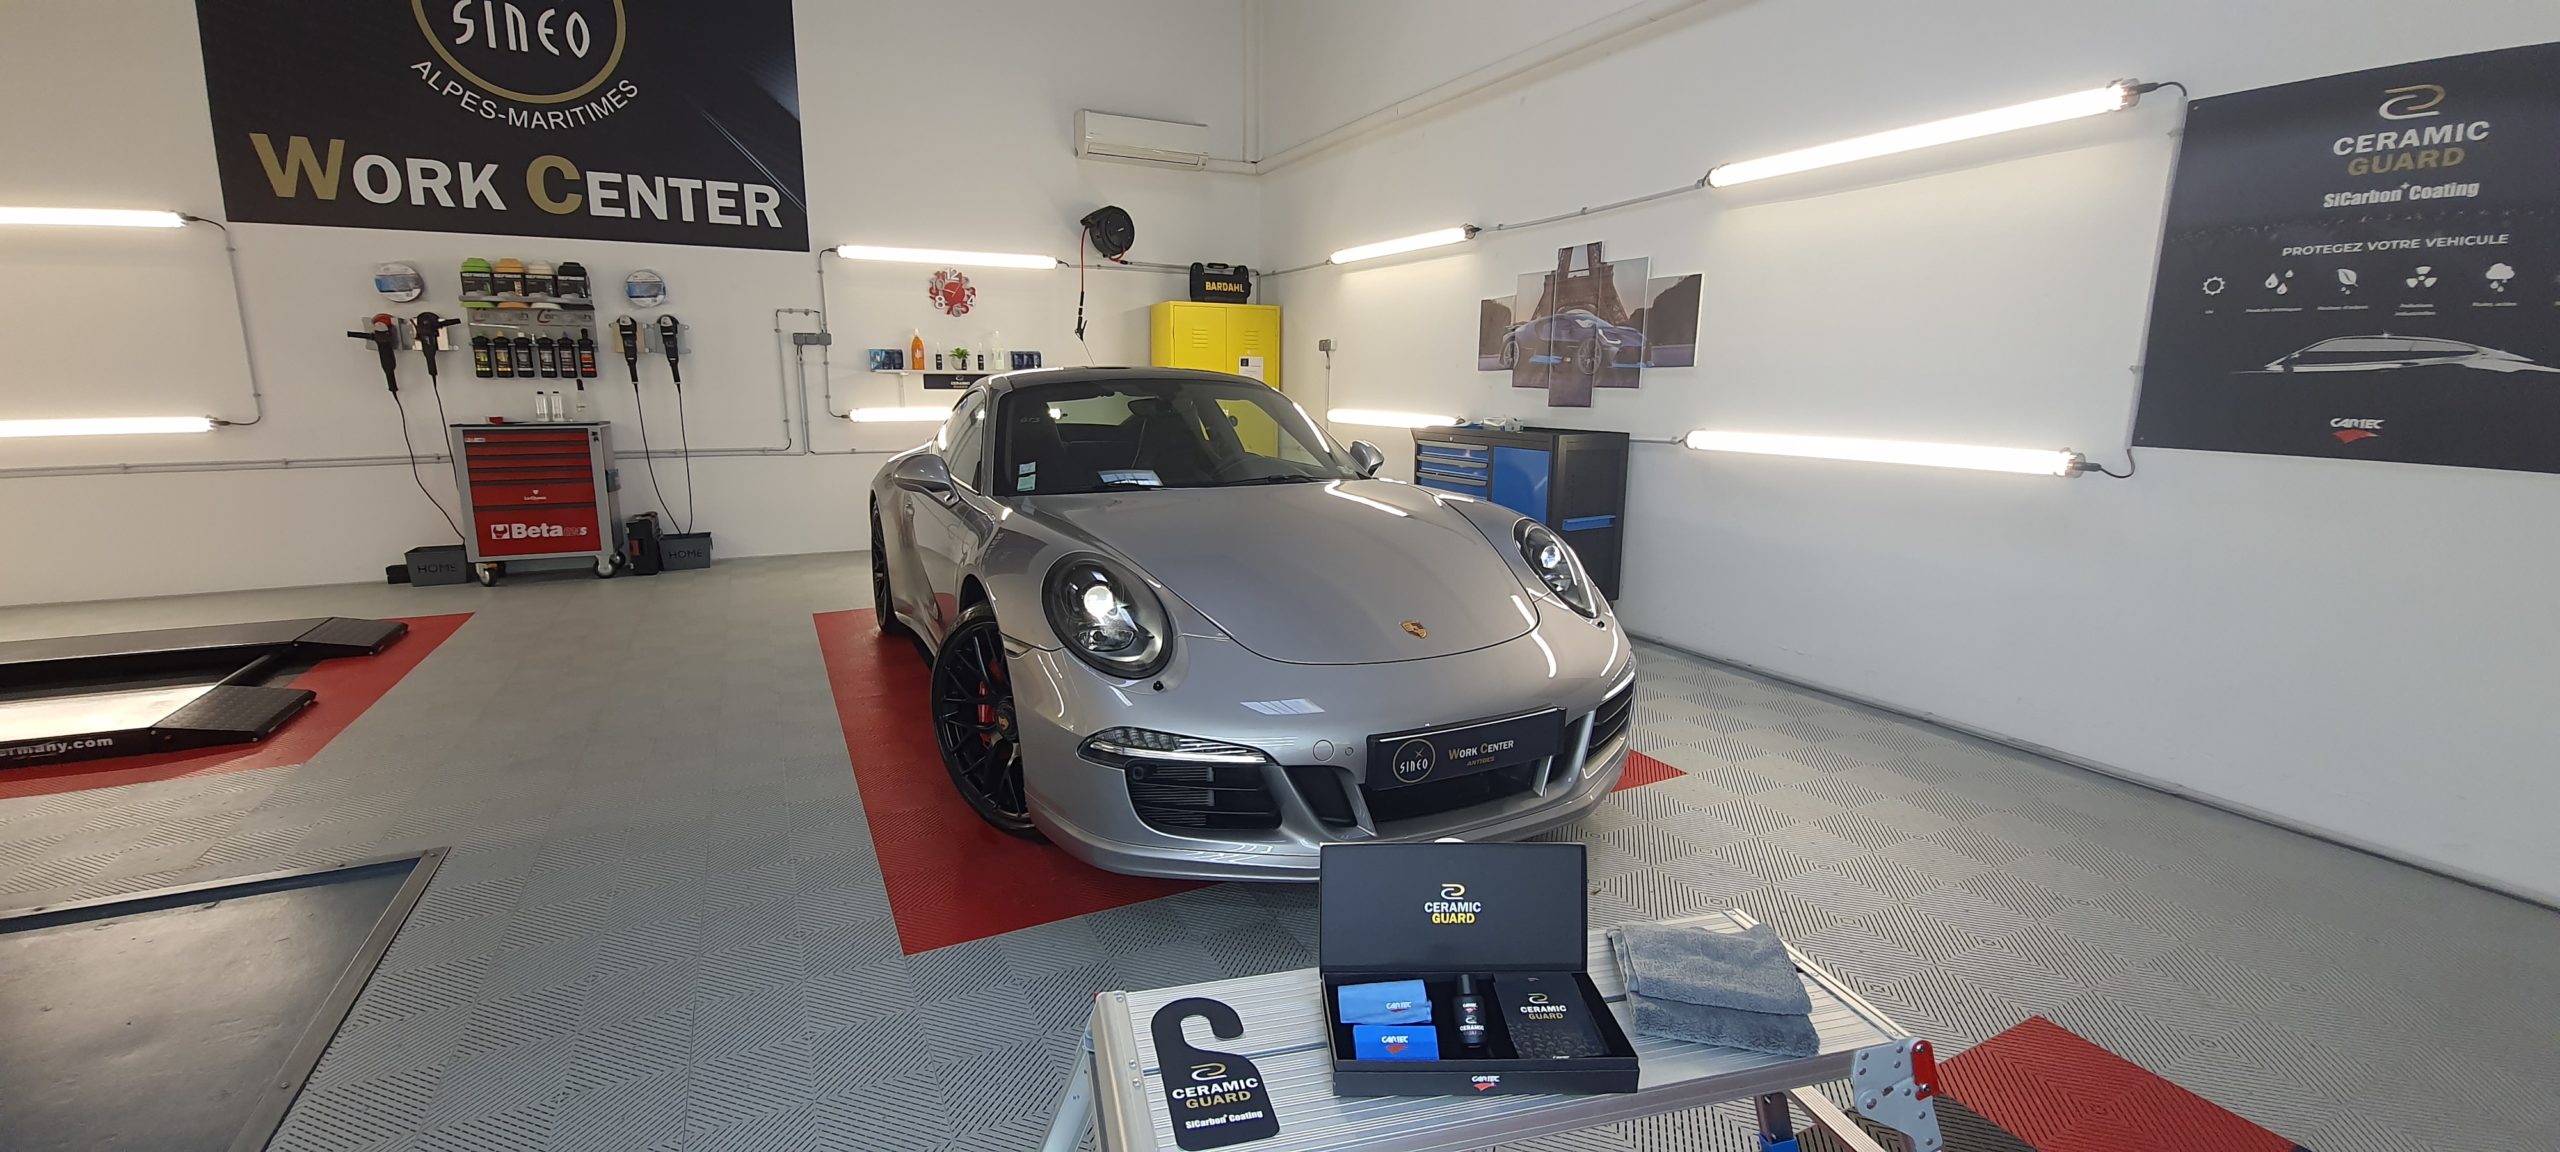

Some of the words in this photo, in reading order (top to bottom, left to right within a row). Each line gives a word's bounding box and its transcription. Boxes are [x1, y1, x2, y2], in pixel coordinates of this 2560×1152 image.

[410, 60, 638, 130] ALPES-MARITIMES
[2333, 120, 2490, 156] CERAMIC
[2347, 147, 2465, 176] GUARD
[249, 132, 507, 211] WORK
[525, 154, 783, 228] CENTER
[2282, 241, 2363, 257] PROTEGEZ
[2368, 237, 2420, 251] VOTRE
[2425, 233, 2509, 249] VEHICULE
[945, 268, 960, 281] 12
[1205, 281, 1245, 293] BARDAHL
[935, 296, 945, 309] 8
[966, 295, 975, 307] 4
[2330, 417, 2385, 430] CARTEC
[511, 523, 563, 539] Beta
[668, 549, 703, 559] HOME
[417, 562, 457, 574] HOME
[1448, 747, 1478, 762] WORK
[1480, 740, 1514, 754] CENTER
[1424, 901, 1481, 913] CERAMIC
[1431, 912, 1476, 924] GUARD
[1520, 1004, 1567, 1014] CERAMIC
[1528, 1012, 1563, 1020] GUARD
[1381, 1035, 1408, 1044] CARTEC
[1172, 1077, 1259, 1100] CERAMIC
[1185, 1091, 1252, 1109] GUARD
[1228, 1110, 1264, 1123] Coating
